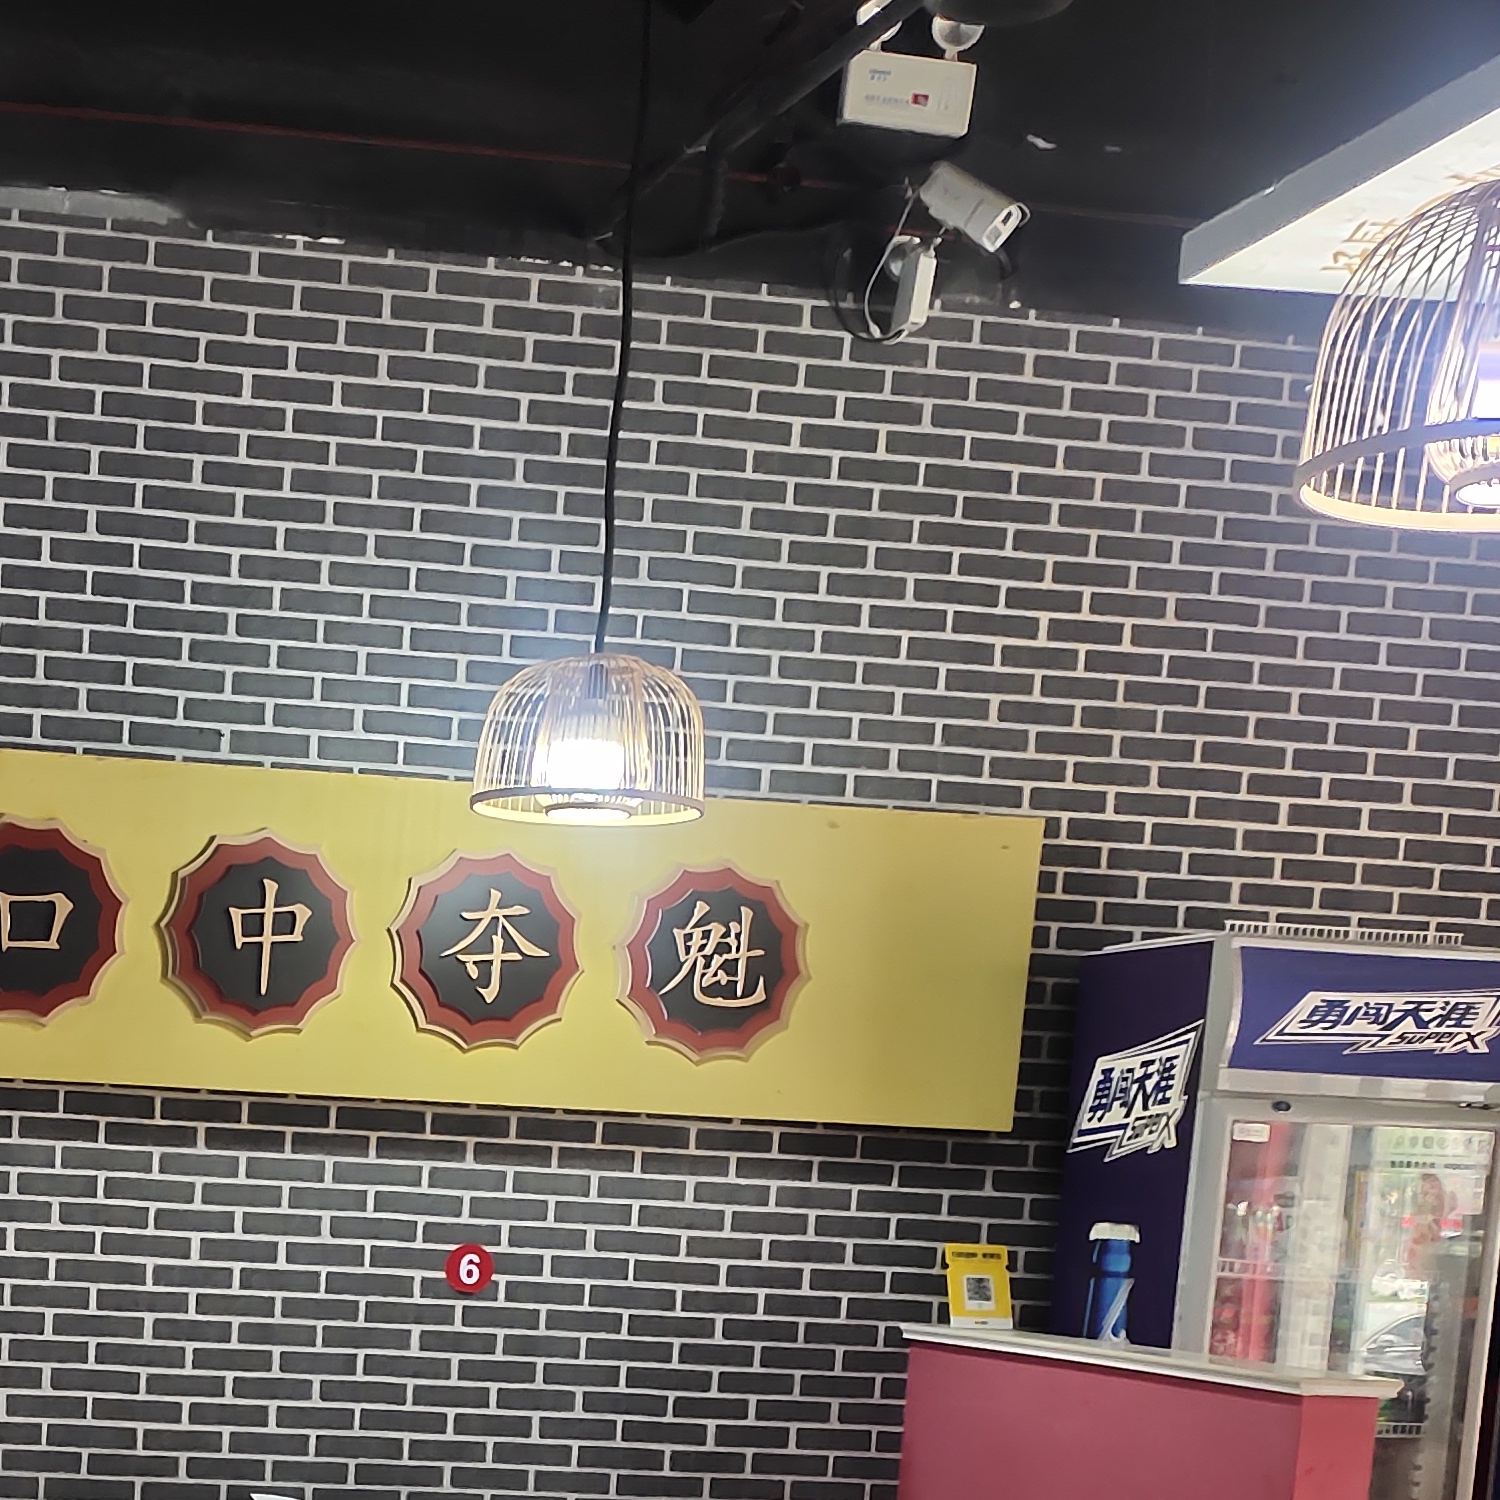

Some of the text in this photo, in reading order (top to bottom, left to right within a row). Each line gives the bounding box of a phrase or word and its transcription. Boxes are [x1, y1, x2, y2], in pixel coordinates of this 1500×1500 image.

[1297, 999, 1486, 1032] 勇闯天涯
[1087, 1054, 1181, 1124] 勇闯天涯
[459, 1253, 481, 1285] 6
